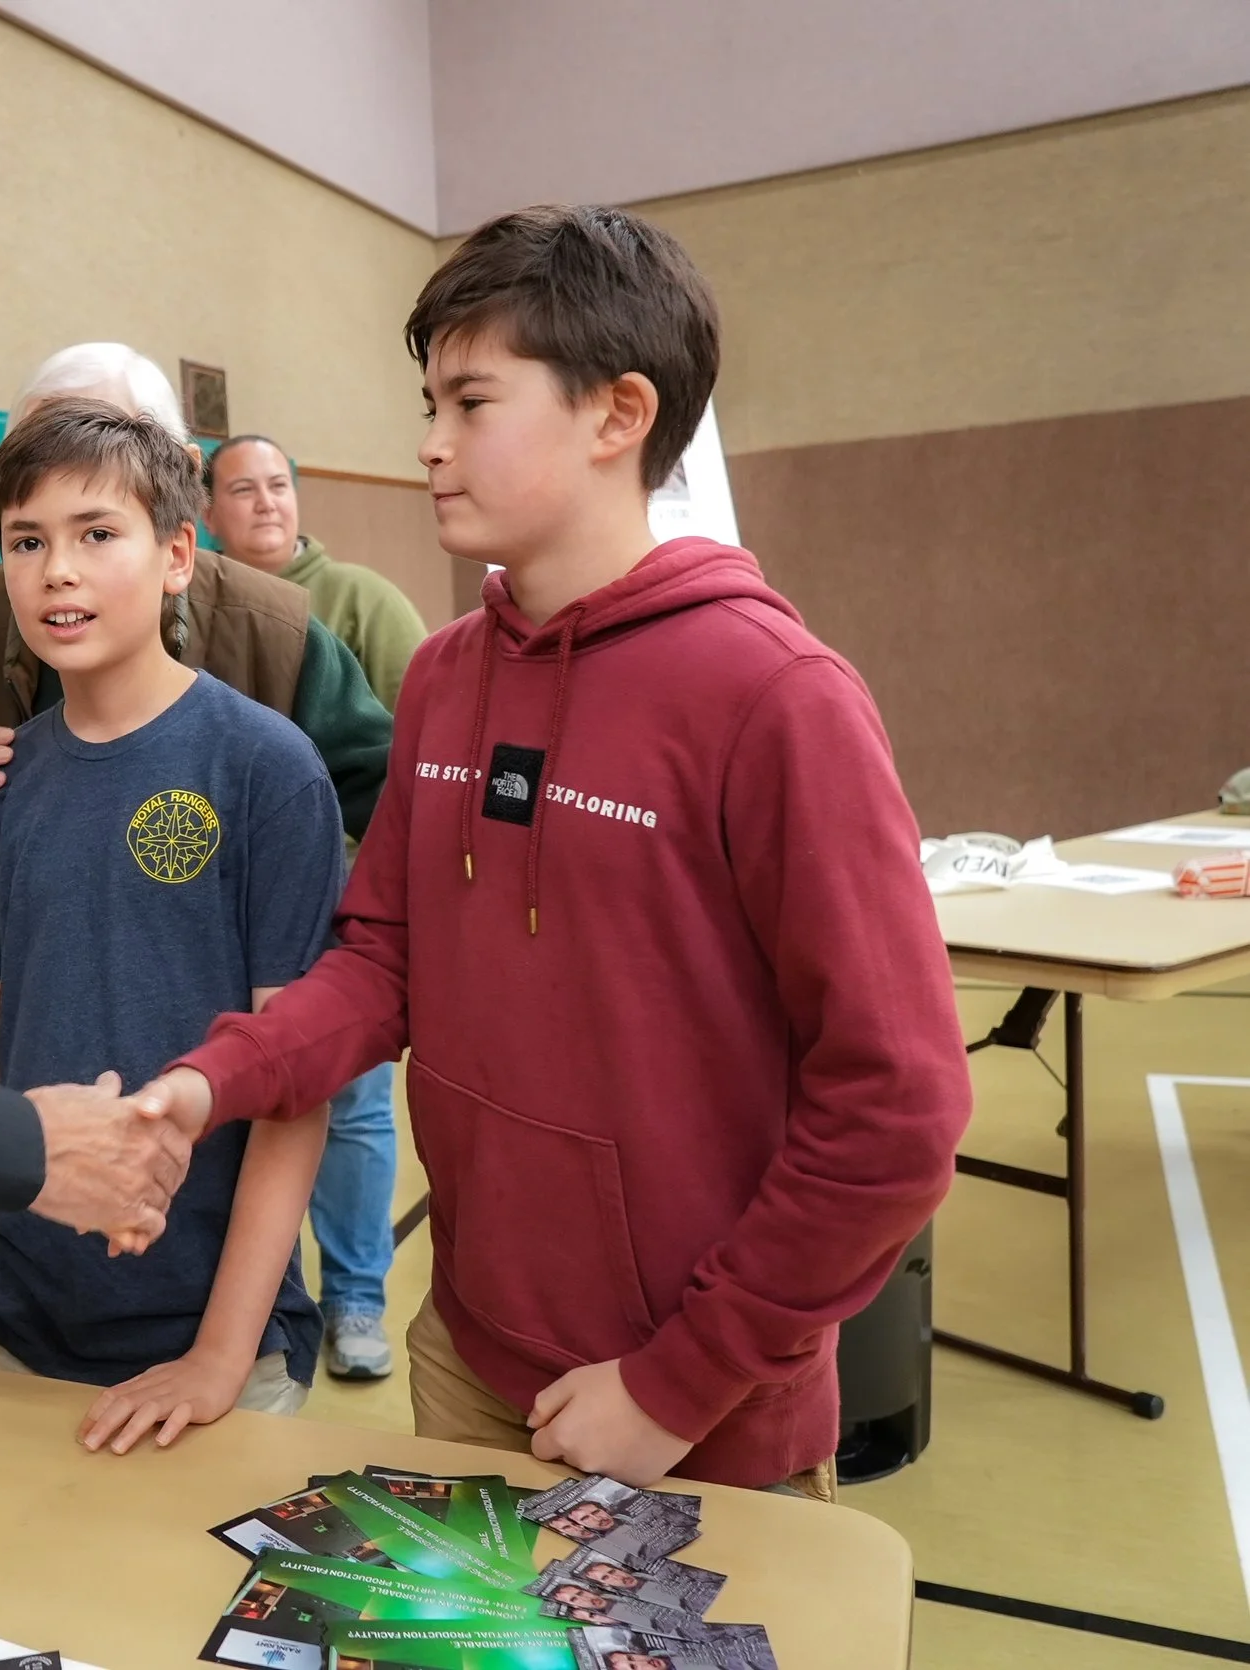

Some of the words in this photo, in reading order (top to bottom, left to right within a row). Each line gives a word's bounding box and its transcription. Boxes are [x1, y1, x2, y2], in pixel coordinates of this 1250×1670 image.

[503, 771, 517, 781] THE
[492, 777, 515, 789] NORTH
[496, 786, 514, 797] FACE
[546, 783, 658, 828] EXPLORING
[131, 796, 166, 829] ROYAL
[170, 792, 217, 833] RANGERS
[347, 1486, 382, 1508] FACILITY?
[280, 1560, 328, 1575] FACILITY?
[329, 1570, 392, 1587] PRODUCTION
[395, 1582, 437, 1596] VIRTUAL
[348, 1630, 401, 1640] FACILITY?
[403, 1631, 472, 1639] PRODUCTION
[474, 1631, 520, 1639] VIRTUAL
